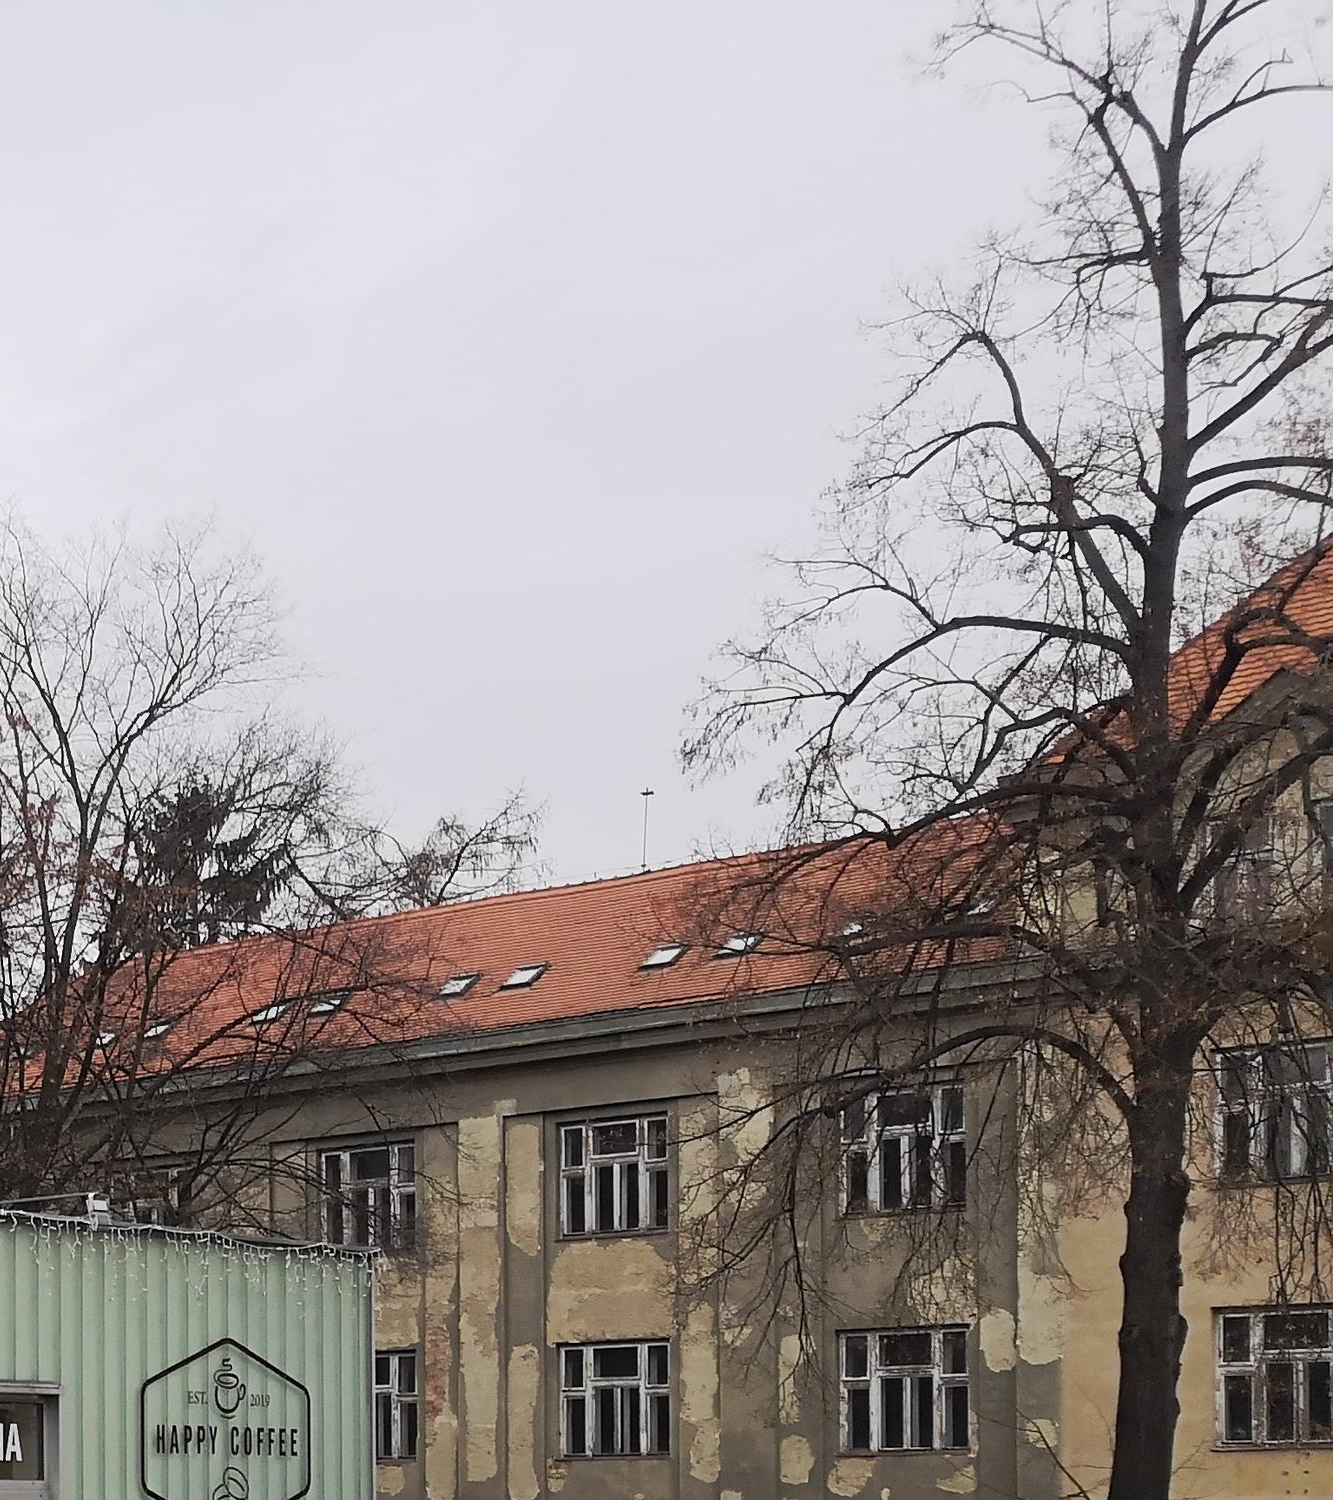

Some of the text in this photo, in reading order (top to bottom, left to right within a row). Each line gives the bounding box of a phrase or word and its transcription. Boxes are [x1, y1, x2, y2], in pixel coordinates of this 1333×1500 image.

[187, 1390, 271, 1408] EST. 2019
[156, 1424, 299, 1457] HAPPY COFFEE
